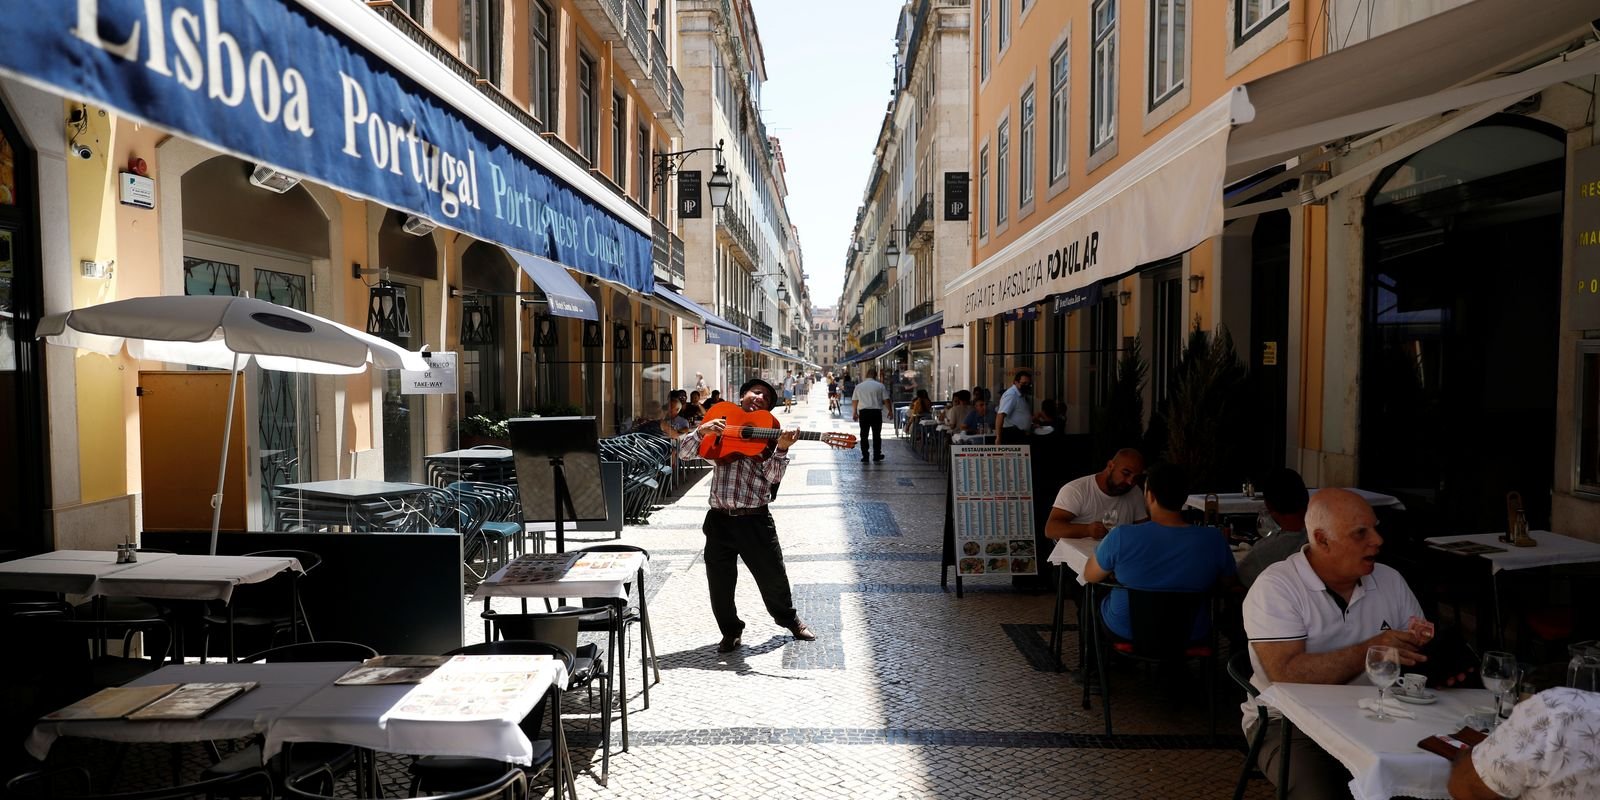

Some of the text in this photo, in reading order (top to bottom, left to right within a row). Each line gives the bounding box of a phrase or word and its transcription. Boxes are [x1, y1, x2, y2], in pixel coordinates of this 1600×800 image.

[70, 0, 314, 138] Lisboa
[338, 70, 481, 218] Portugal
[1046, 231, 1099, 283] POPULAR
